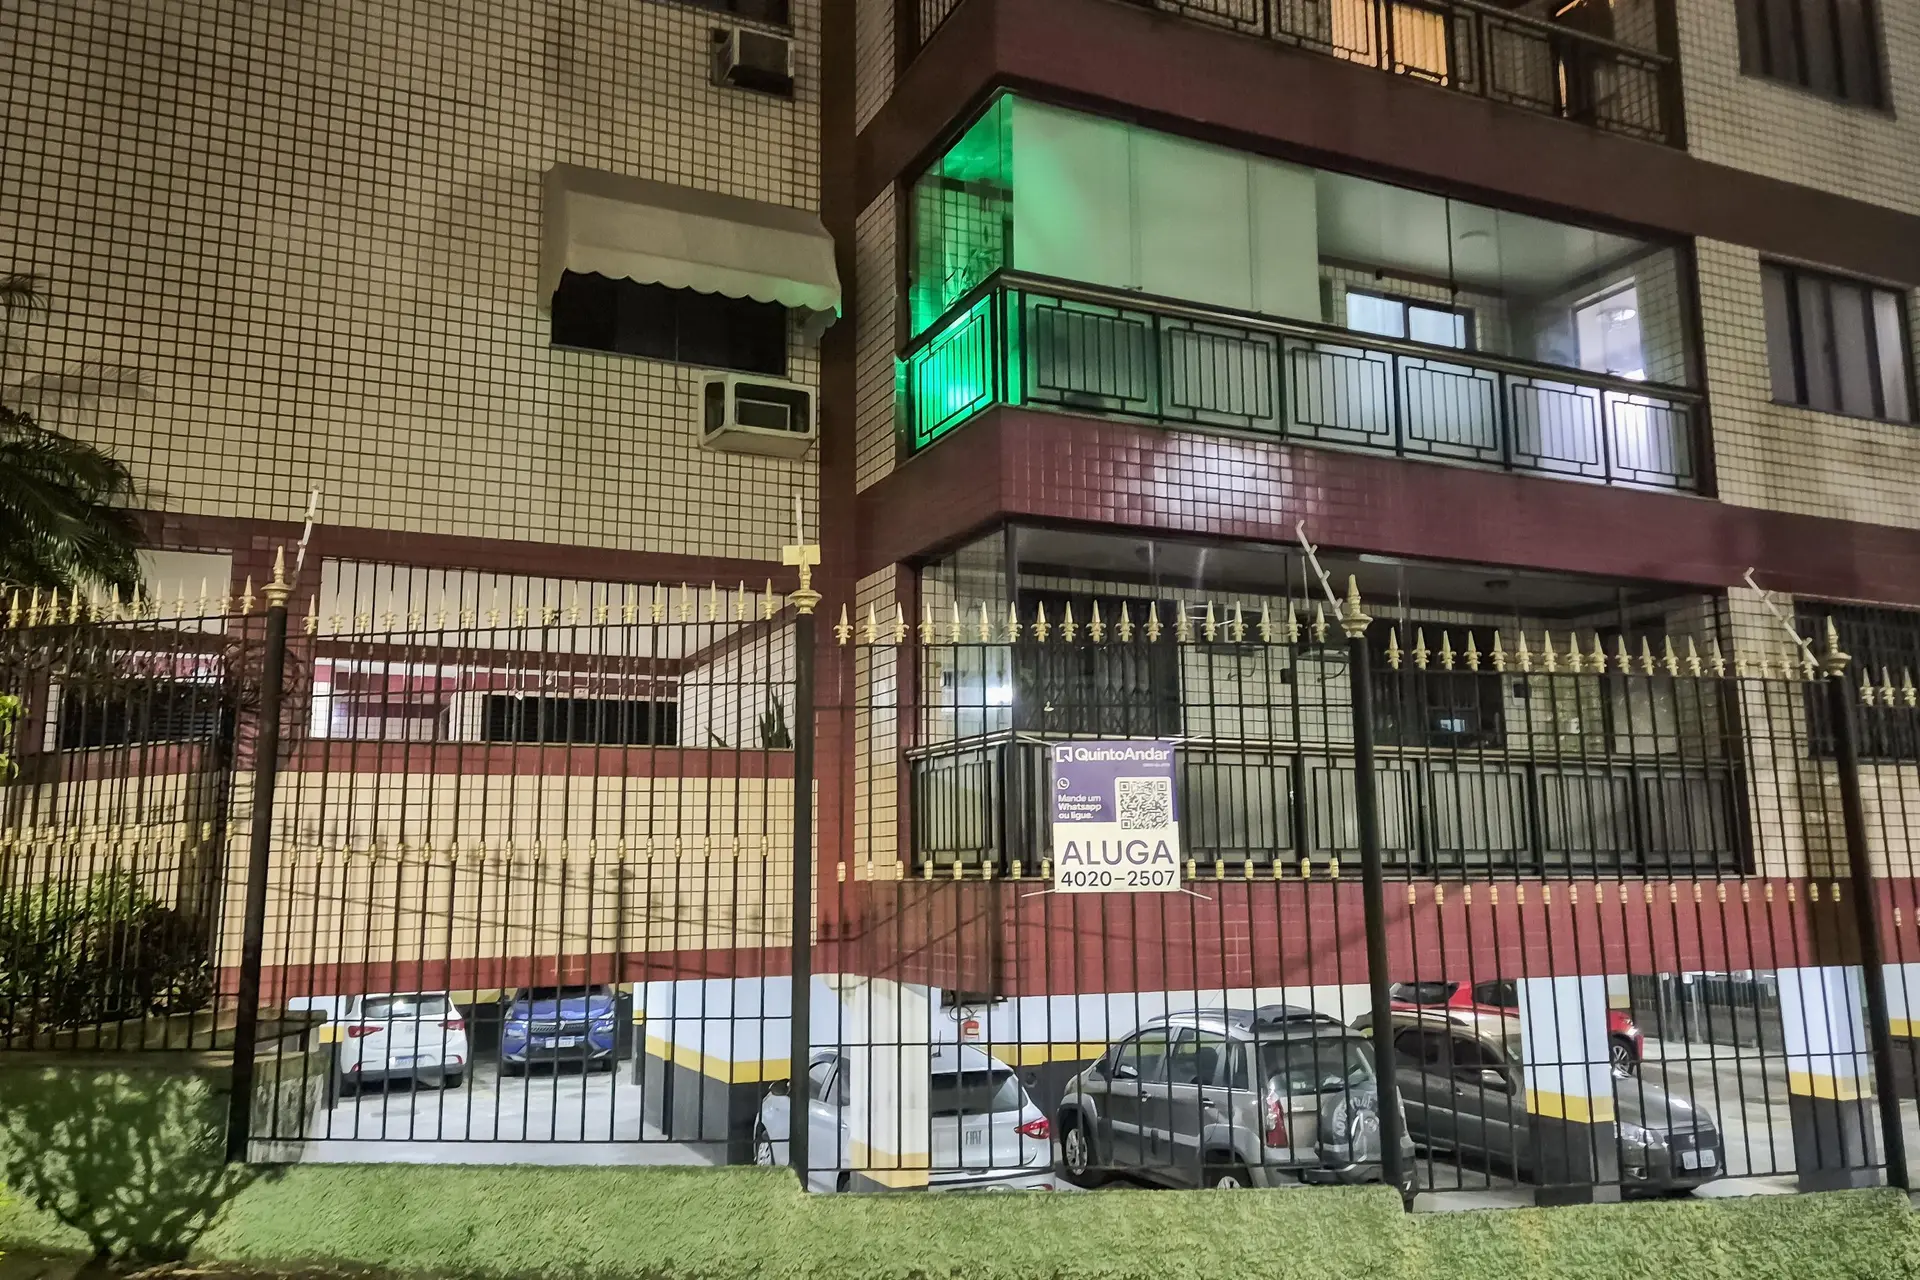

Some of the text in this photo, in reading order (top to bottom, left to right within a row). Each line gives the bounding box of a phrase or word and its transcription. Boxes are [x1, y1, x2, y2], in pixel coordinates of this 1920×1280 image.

[1075, 747, 1170, 762] QuintoAndar
[1058, 794, 1087, 802] Mande
[1071, 811, 1094, 820] ligue.
[1061, 840, 1174, 865] ALUGA
[1061, 870, 1175, 887] 4020-2507
[966, 1130, 982, 1145] FIAT
